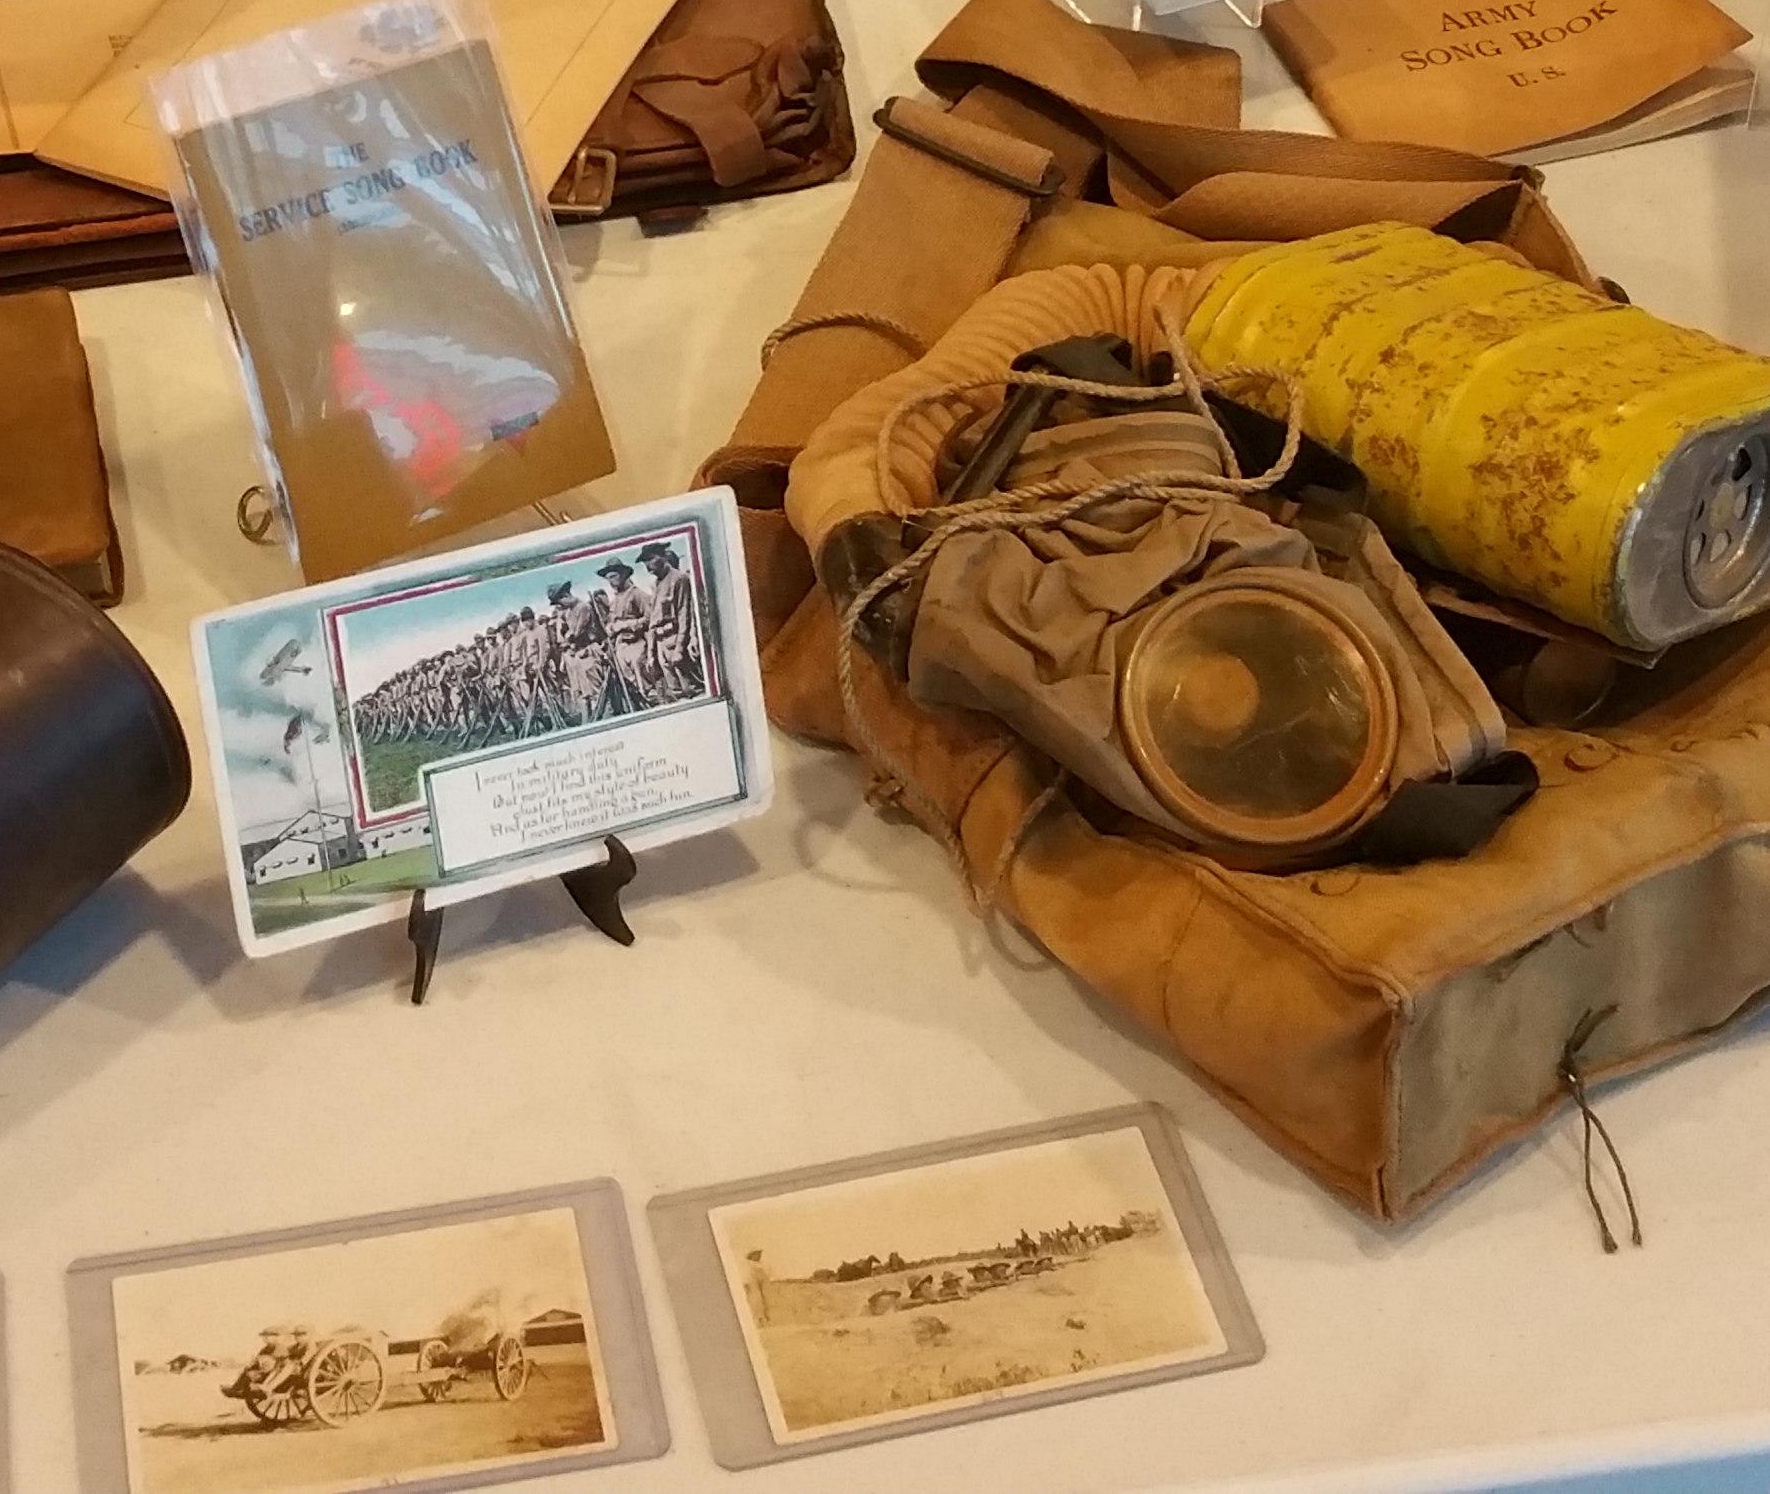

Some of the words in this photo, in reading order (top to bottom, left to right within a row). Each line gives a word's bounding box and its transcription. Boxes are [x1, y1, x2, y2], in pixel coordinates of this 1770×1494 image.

[1400, 39, 1502, 72] SONG
[1510, 0, 1618, 51] BOOK
[1441, 0, 1538, 32] ARMY
[1507, 72, 1538, 88] U.
[1541, 66, 1566, 80] S.
[336, 142, 370, 171] THE
[239, 189, 332, 242] SERVICE
[344, 168, 406, 205] SONG
[413, 139, 478, 180] BOOK
[475, 770, 480, 791] I
[482, 771, 513, 785] never
[516, 760, 538, 776] took
[543, 751, 575, 770] much
[579, 740, 625, 761] interest
